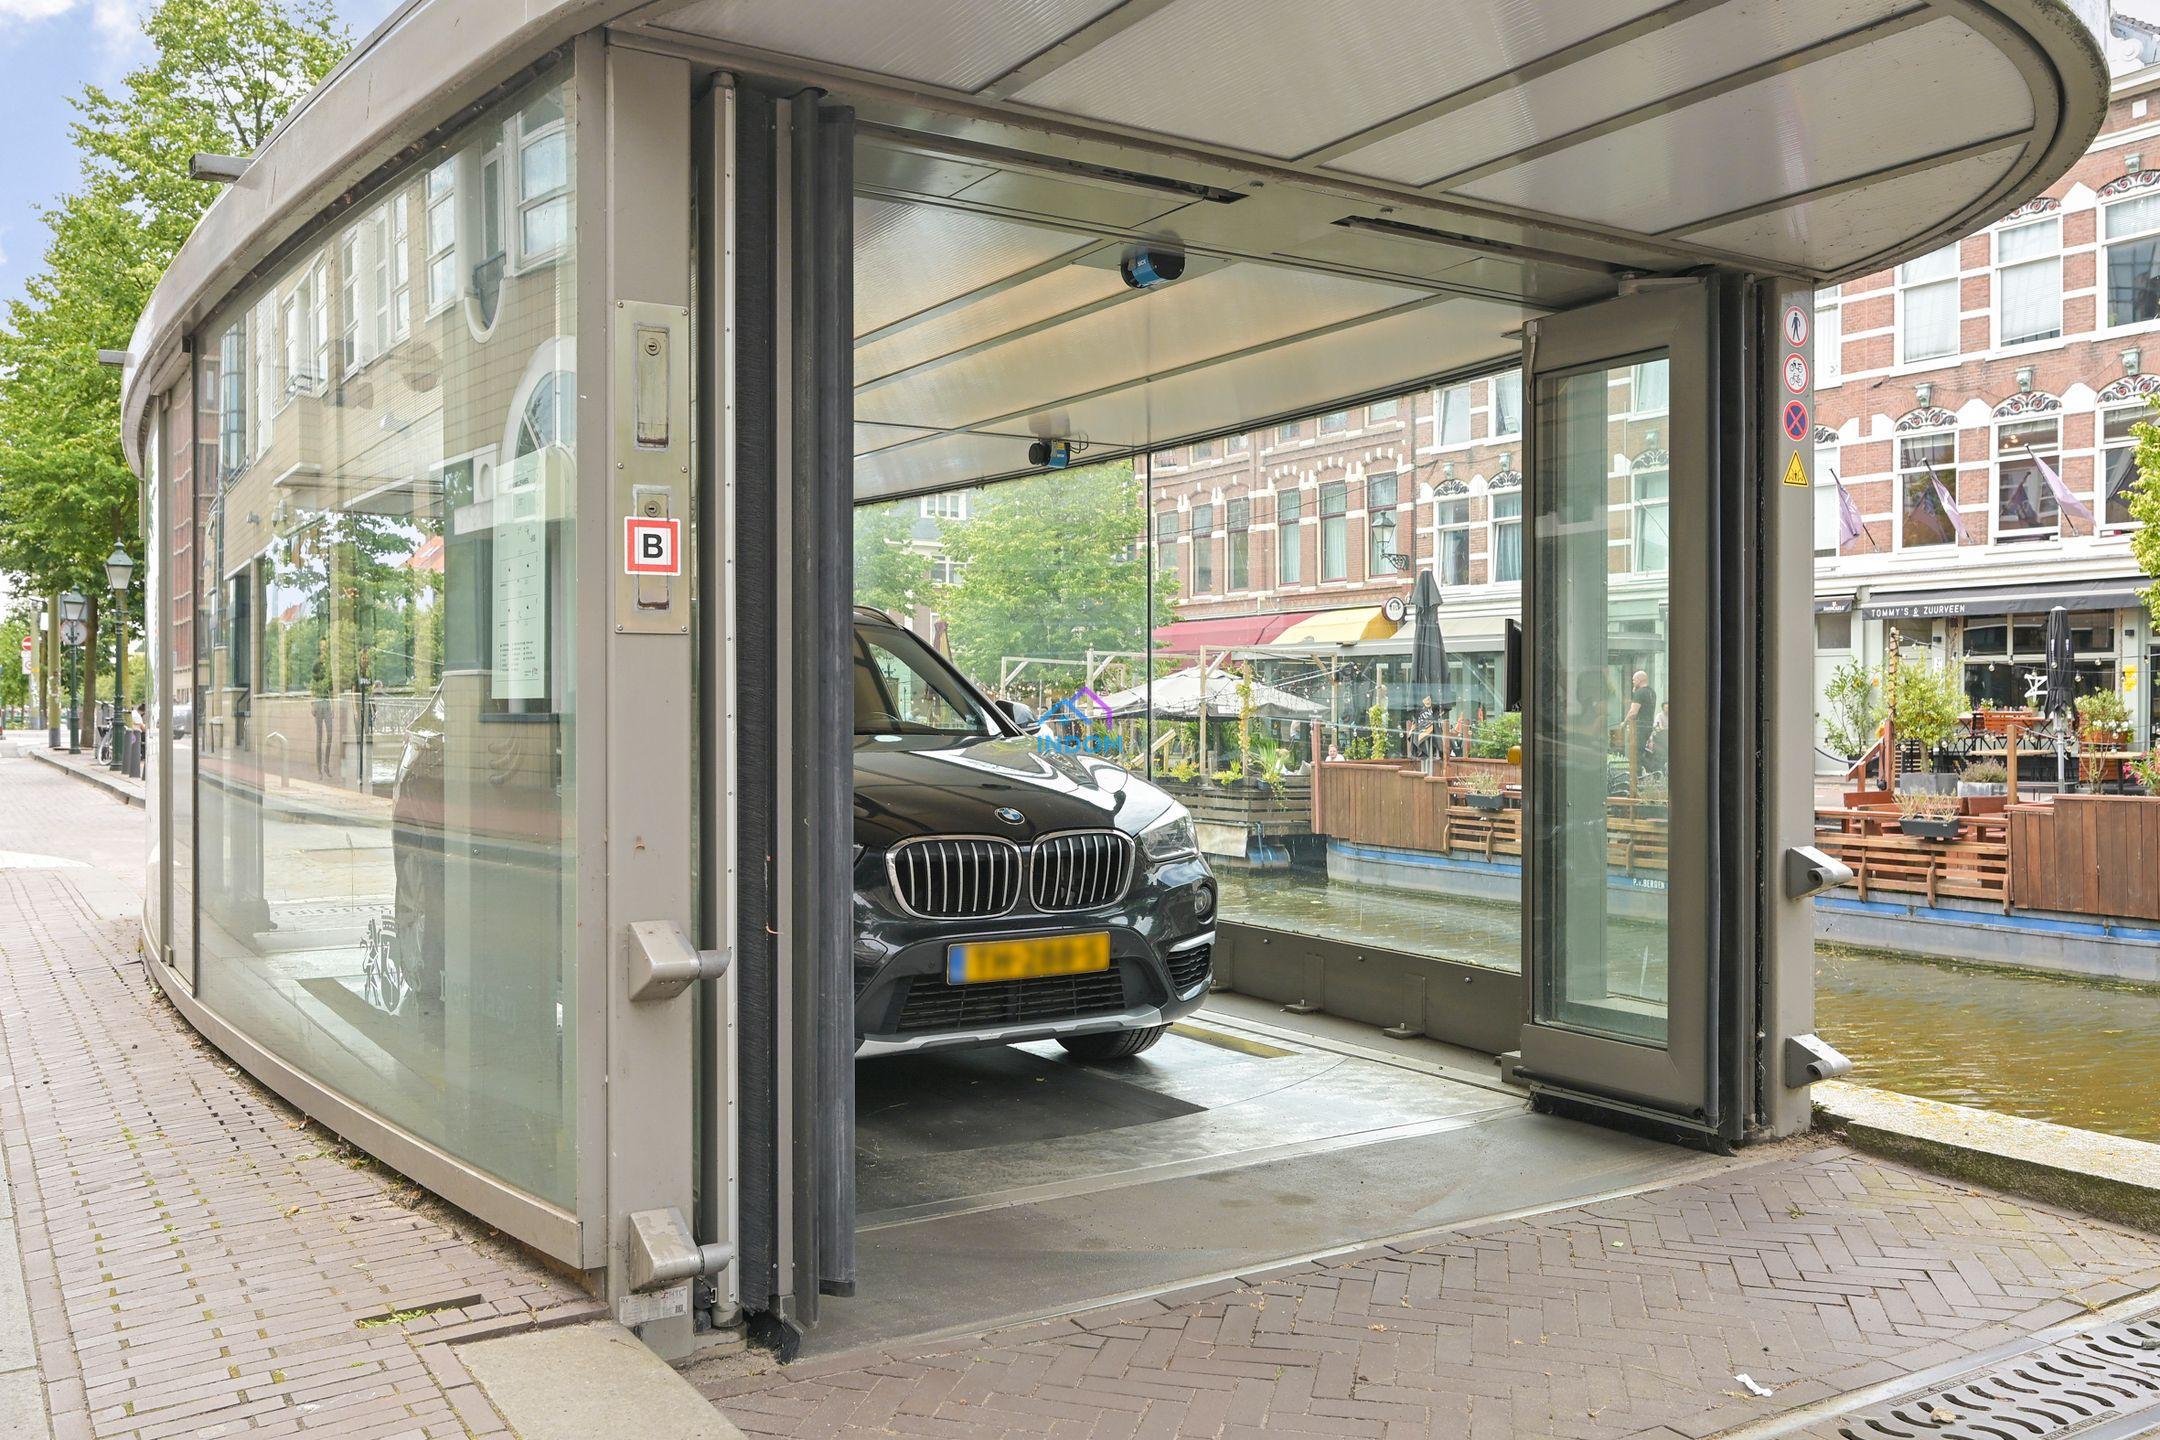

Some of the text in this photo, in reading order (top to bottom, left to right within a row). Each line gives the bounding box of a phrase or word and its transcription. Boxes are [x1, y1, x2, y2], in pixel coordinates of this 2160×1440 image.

[643, 533, 663, 559] B
[1871, 605, 1966, 618] TOMMY'S & ZUURVEEN
